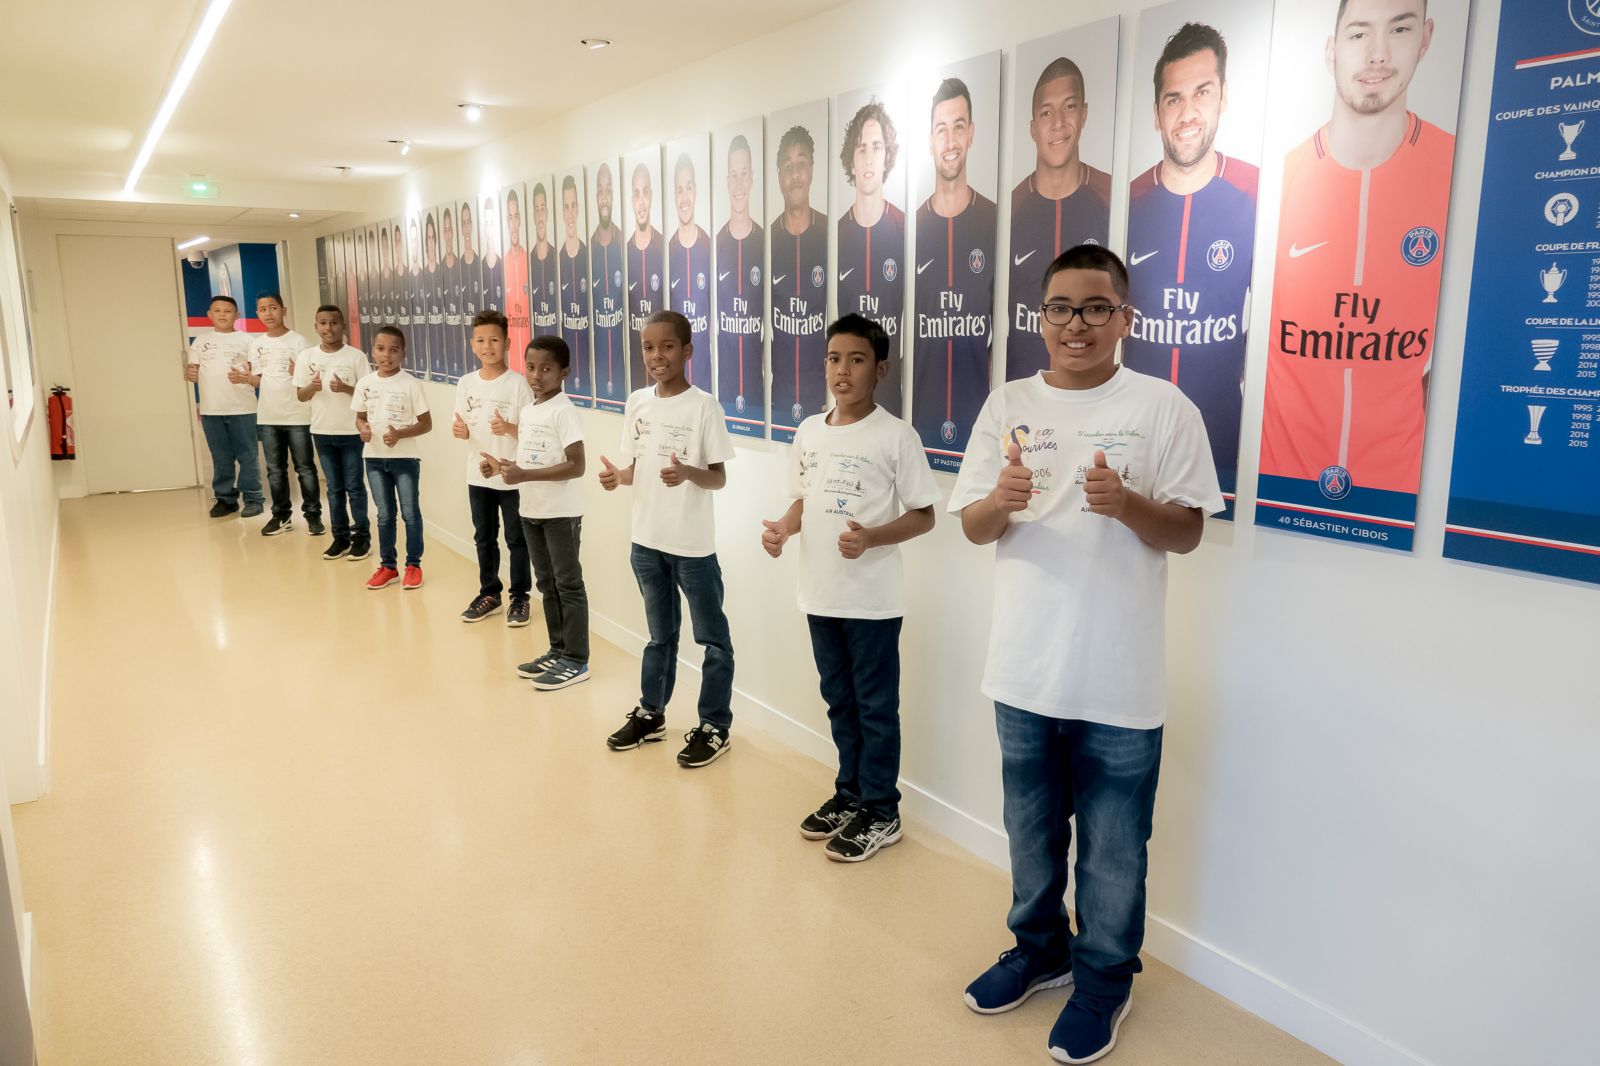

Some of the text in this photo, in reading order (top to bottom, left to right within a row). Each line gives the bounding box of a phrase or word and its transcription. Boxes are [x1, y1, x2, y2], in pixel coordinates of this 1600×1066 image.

[1550, 72, 1600, 90] PALM
[1496, 109, 1534, 121] COUPE
[1537, 105, 1560, 116] DES
[1534, 168, 1588, 180] CHAMPION
[1409, 230, 1434, 238] PARIS
[1535, 243, 1569, 252] COUPE
[1586, 242, 1600, 250] FR
[571, 302, 580, 315] Fly
[604, 298, 614, 311] Fly
[640, 300, 652, 314] Fly
[684, 300, 696, 316] Fly
[733, 298, 748, 314] Fly
[790, 297, 807, 316] Fly
[859, 294, 879, 314] Fly
[940, 290, 963, 312] Fly
[1164, 288, 1200, 314] Fly
[1334, 292, 1381, 324] Fly
[564, 312, 588, 330] Emirates
[595, 308, 623, 328] Emirates
[720, 312, 760, 334] Emirates
[774, 306, 823, 335] Emirates
[919, 310, 986, 338] Emirates
[1130, 308, 1236, 344] Emirates
[1280, 320, 1428, 361] Emirates
[1500, 385, 1545, 394] TROPHÉE
[941, 459, 960, 467] PASTOR
[1031, 468, 1052, 478] 006
[1278, 516, 1388, 540] 40 SÉBASTIEN CIBOIS
